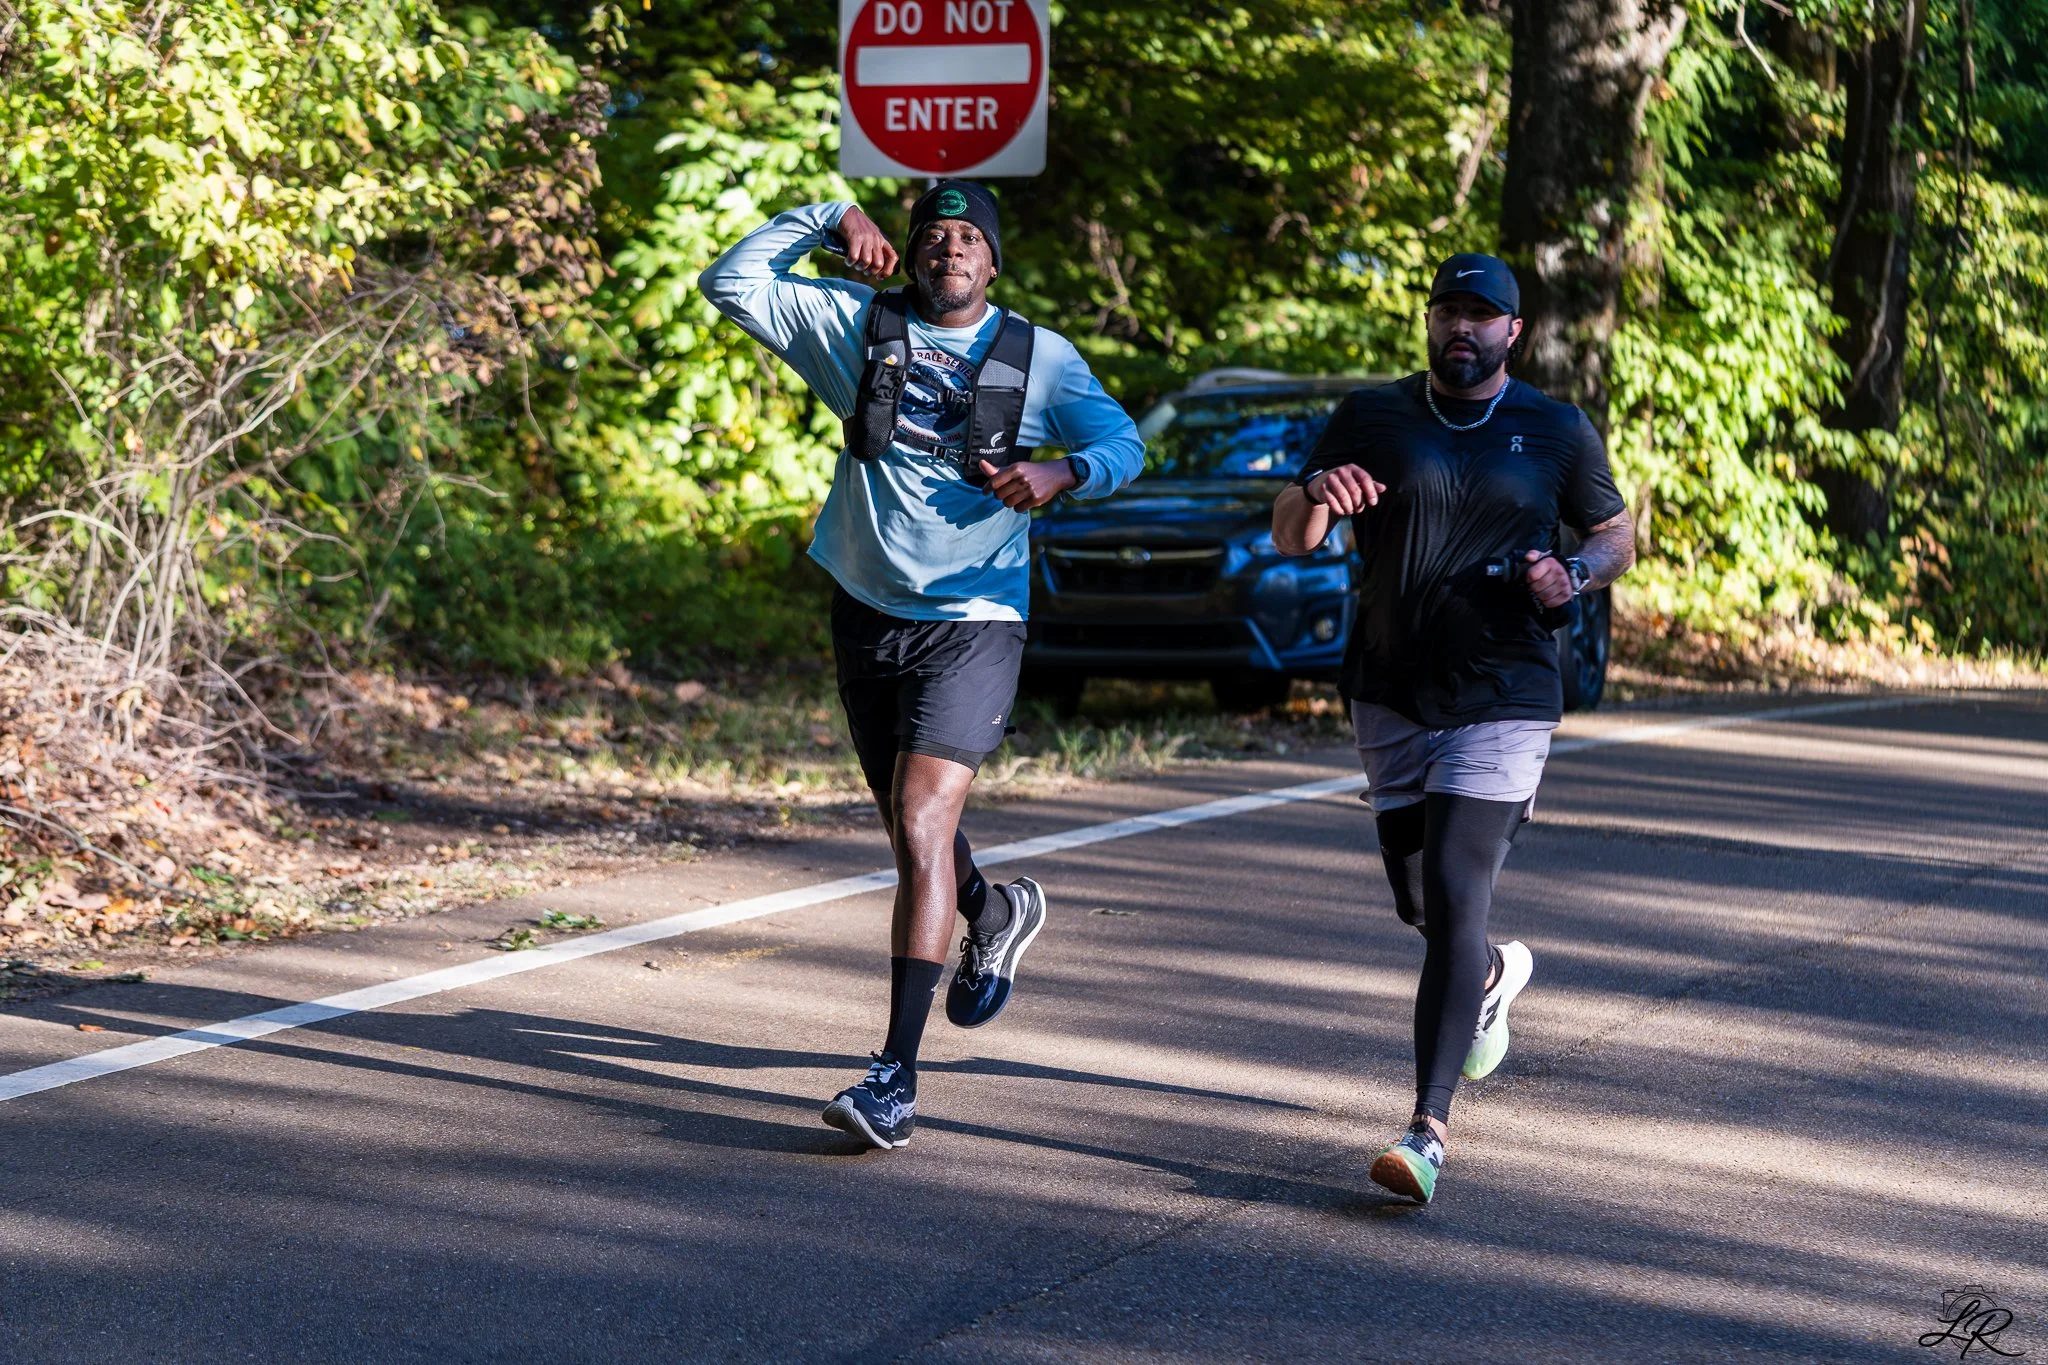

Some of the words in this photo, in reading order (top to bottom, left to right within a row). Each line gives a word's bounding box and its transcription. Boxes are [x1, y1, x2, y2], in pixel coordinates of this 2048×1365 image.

[874, 0, 923, 36] DO
[944, 0, 1015, 34] NOT
[885, 96, 999, 132] ENTER
[916, 351, 943, 363] RACE
